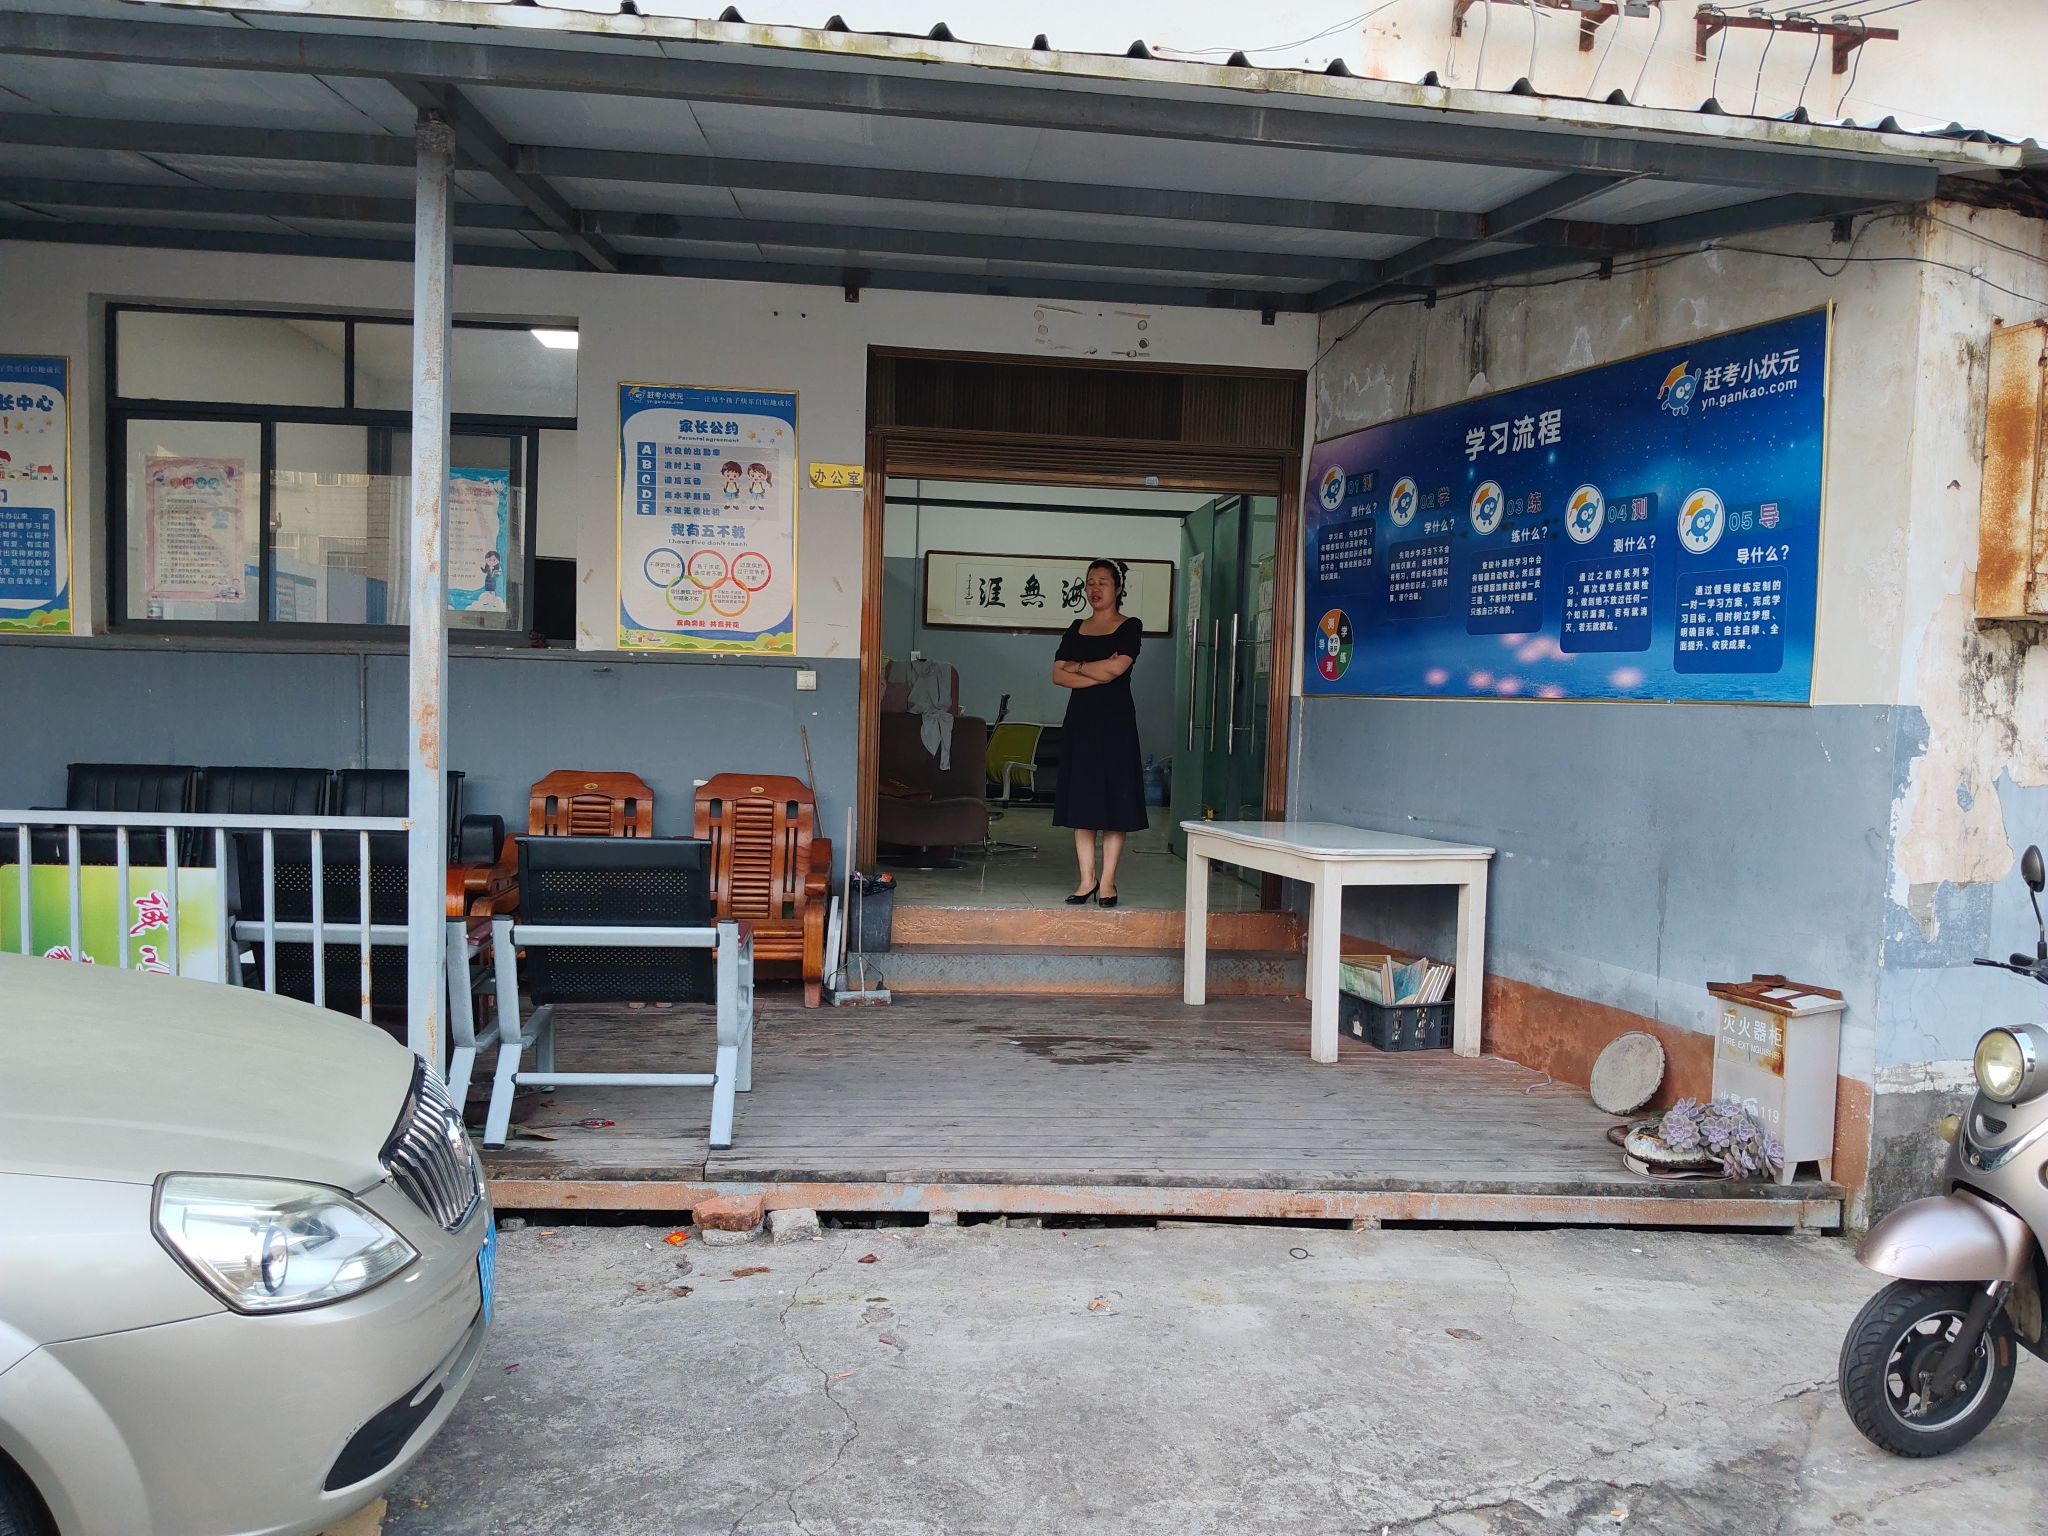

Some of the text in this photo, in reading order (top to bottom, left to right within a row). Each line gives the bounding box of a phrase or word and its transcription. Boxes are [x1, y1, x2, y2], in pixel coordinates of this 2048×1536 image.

[1703, 348, 1800, 393] 赶考小状元
[1701, 379, 1798, 411] yn.gankao.com
[679, 420, 740, 436] 家长公约
[1464, 409, 1562, 461] 学习流程
[642, 445, 652, 455] A
[642, 459, 702, 471] B 准时上课
[642, 474, 651, 484] C
[814, 467, 861, 486] 办公室
[642, 489, 652, 499] D
[1420, 486, 1450, 510] 02 学
[642, 503, 650, 513] E
[1506, 491, 1542, 516] 03 练
[1608, 497, 1648, 523] 04 测
[1728, 503, 1780, 531] 05 导
[671, 522, 746, 540] 我有五不教
[1579, 567, 1650, 582] 通过之前的系列学
[1695, 580, 1782, 596] 通过督导教练定制的
[1680, 624, 1779, 637] 明确目标、自主自律、全
[1680, 639, 1752, 651] 面提升、收获成果。
[1722, 1012, 1783, 1048] 灭火器柜
[1722, 1036, 1782, 1061] FIRE EXTNGUISHER
[1761, 1105, 1779, 1124] 119
